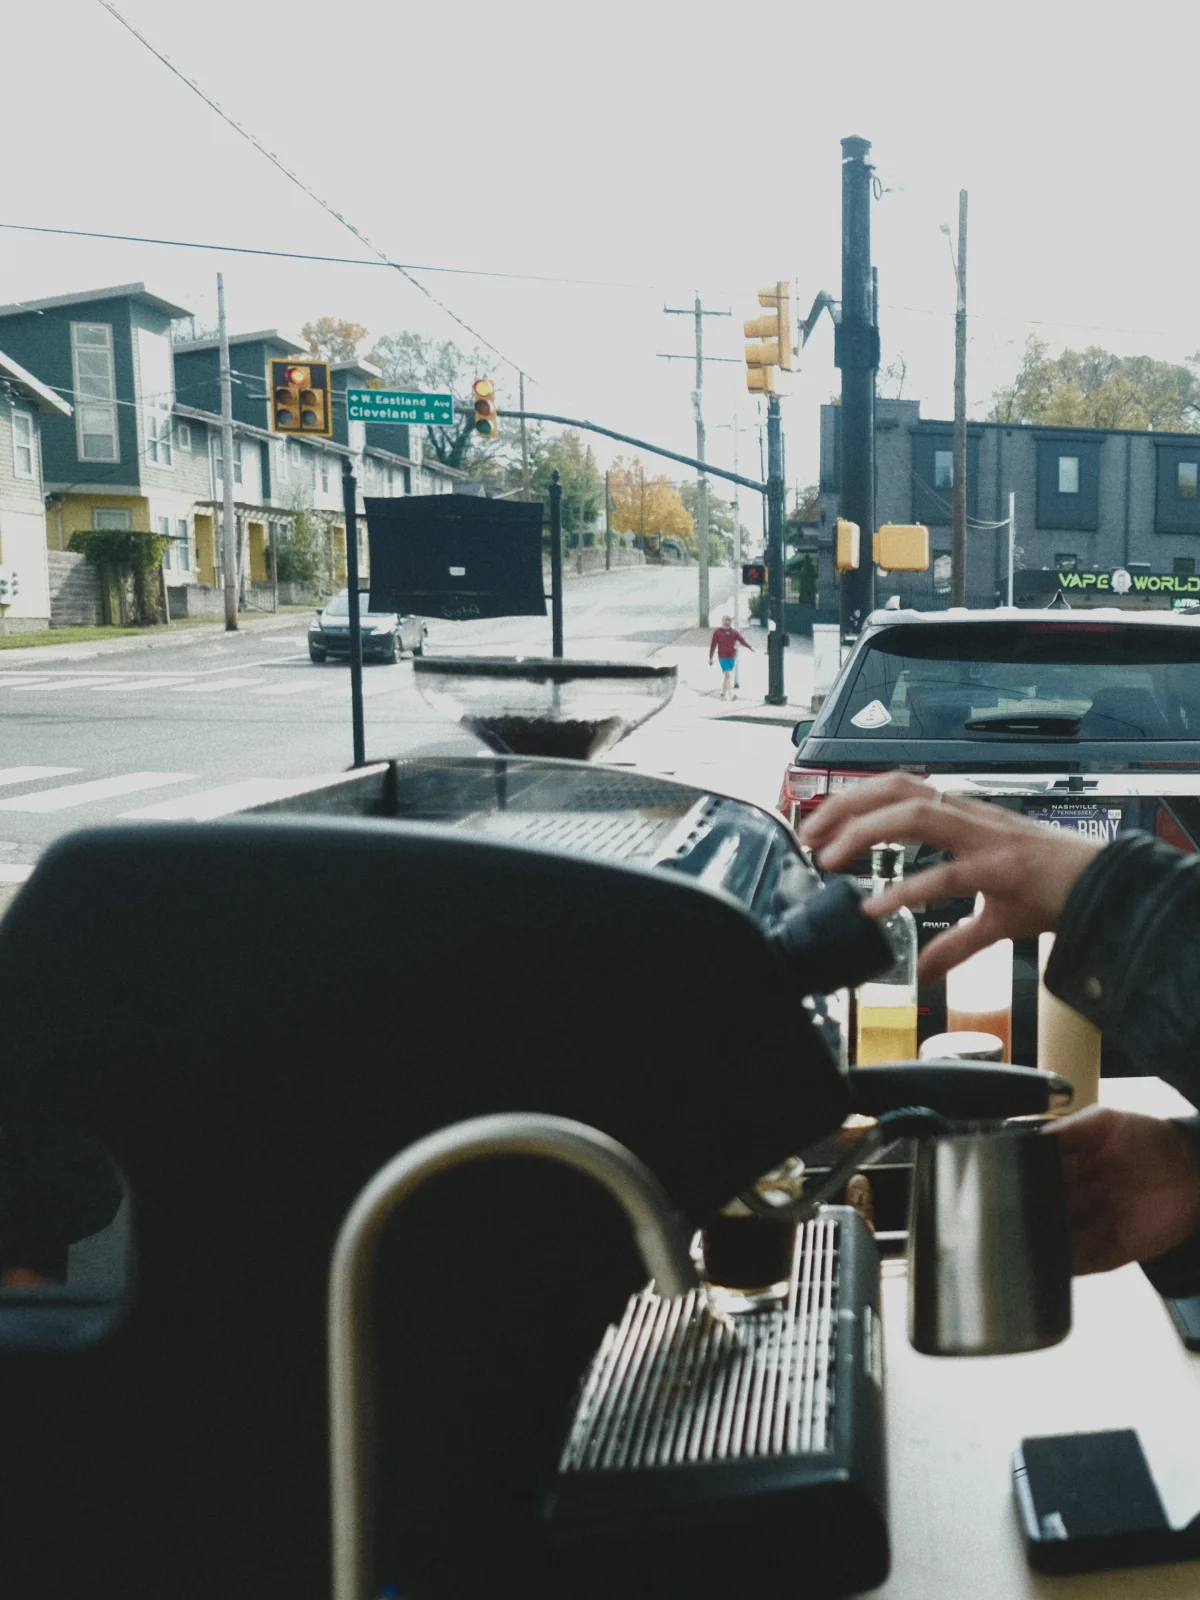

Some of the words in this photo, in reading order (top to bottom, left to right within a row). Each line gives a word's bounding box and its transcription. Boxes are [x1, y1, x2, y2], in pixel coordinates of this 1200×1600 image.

[361, 394, 373, 404] W.
[375, 395, 427, 407] Eastland
[350, 406, 417, 420] Cleveland
[423, 411, 435, 420] St
[1058, 573, 1109, 589] VAPE
[922, 921, 950, 929] AWD
